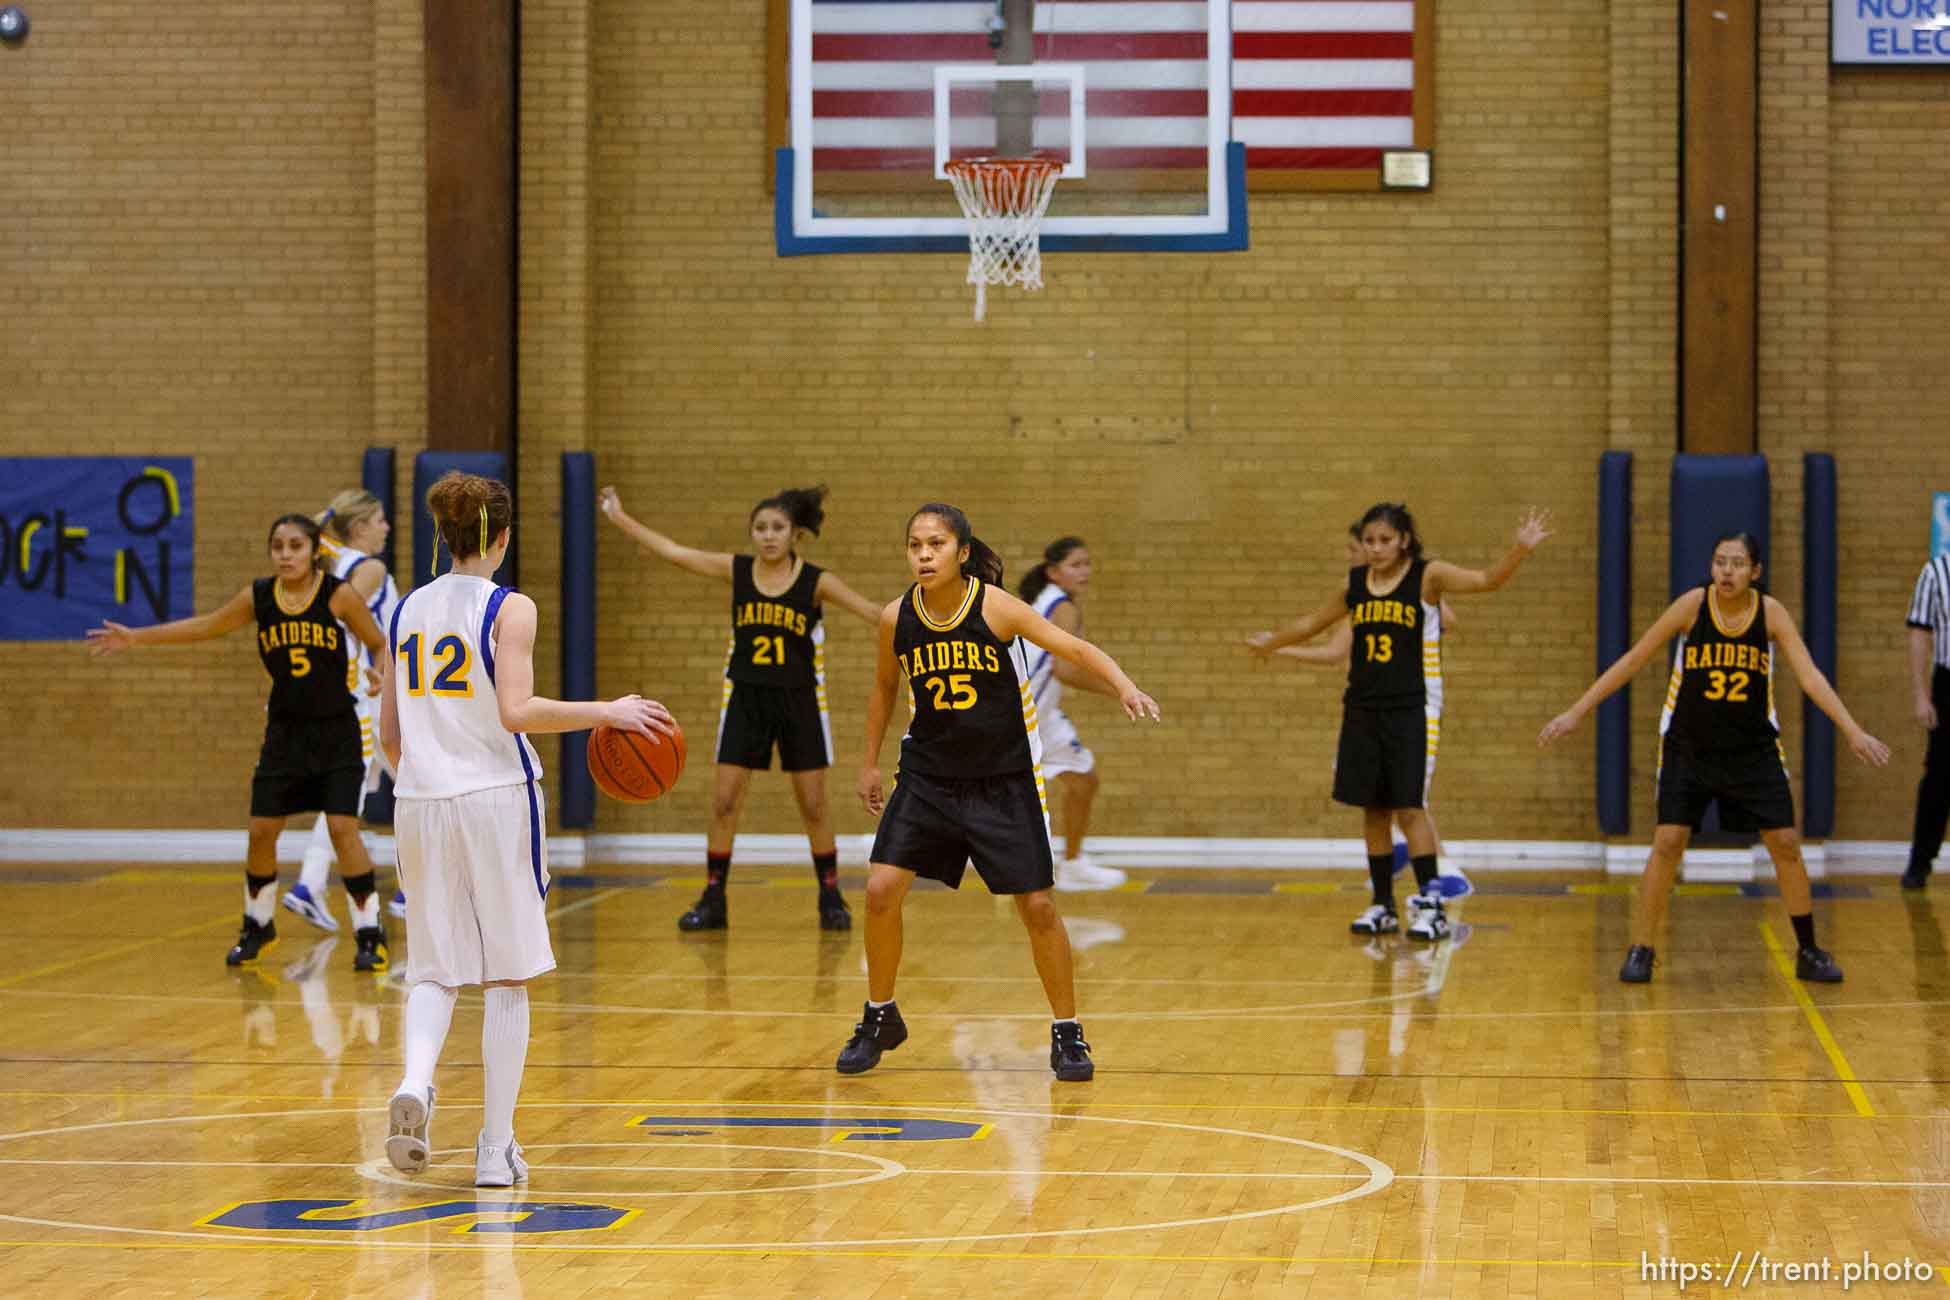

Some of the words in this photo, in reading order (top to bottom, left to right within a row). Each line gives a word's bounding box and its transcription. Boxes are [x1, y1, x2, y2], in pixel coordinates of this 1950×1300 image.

[1857, 0, 1950, 18] NOR
[0, 509, 89, 599] CK
[1353, 600, 1416, 629] AIDERS
[288, 647, 311, 677] 5
[752, 636, 785, 665] 21
[1366, 633, 1392, 663] 13
[1685, 643, 1769, 675] RAIDERS
[398, 631, 474, 697] 12
[925, 674, 978, 711] 25
[1704, 670, 1749, 701] 32
